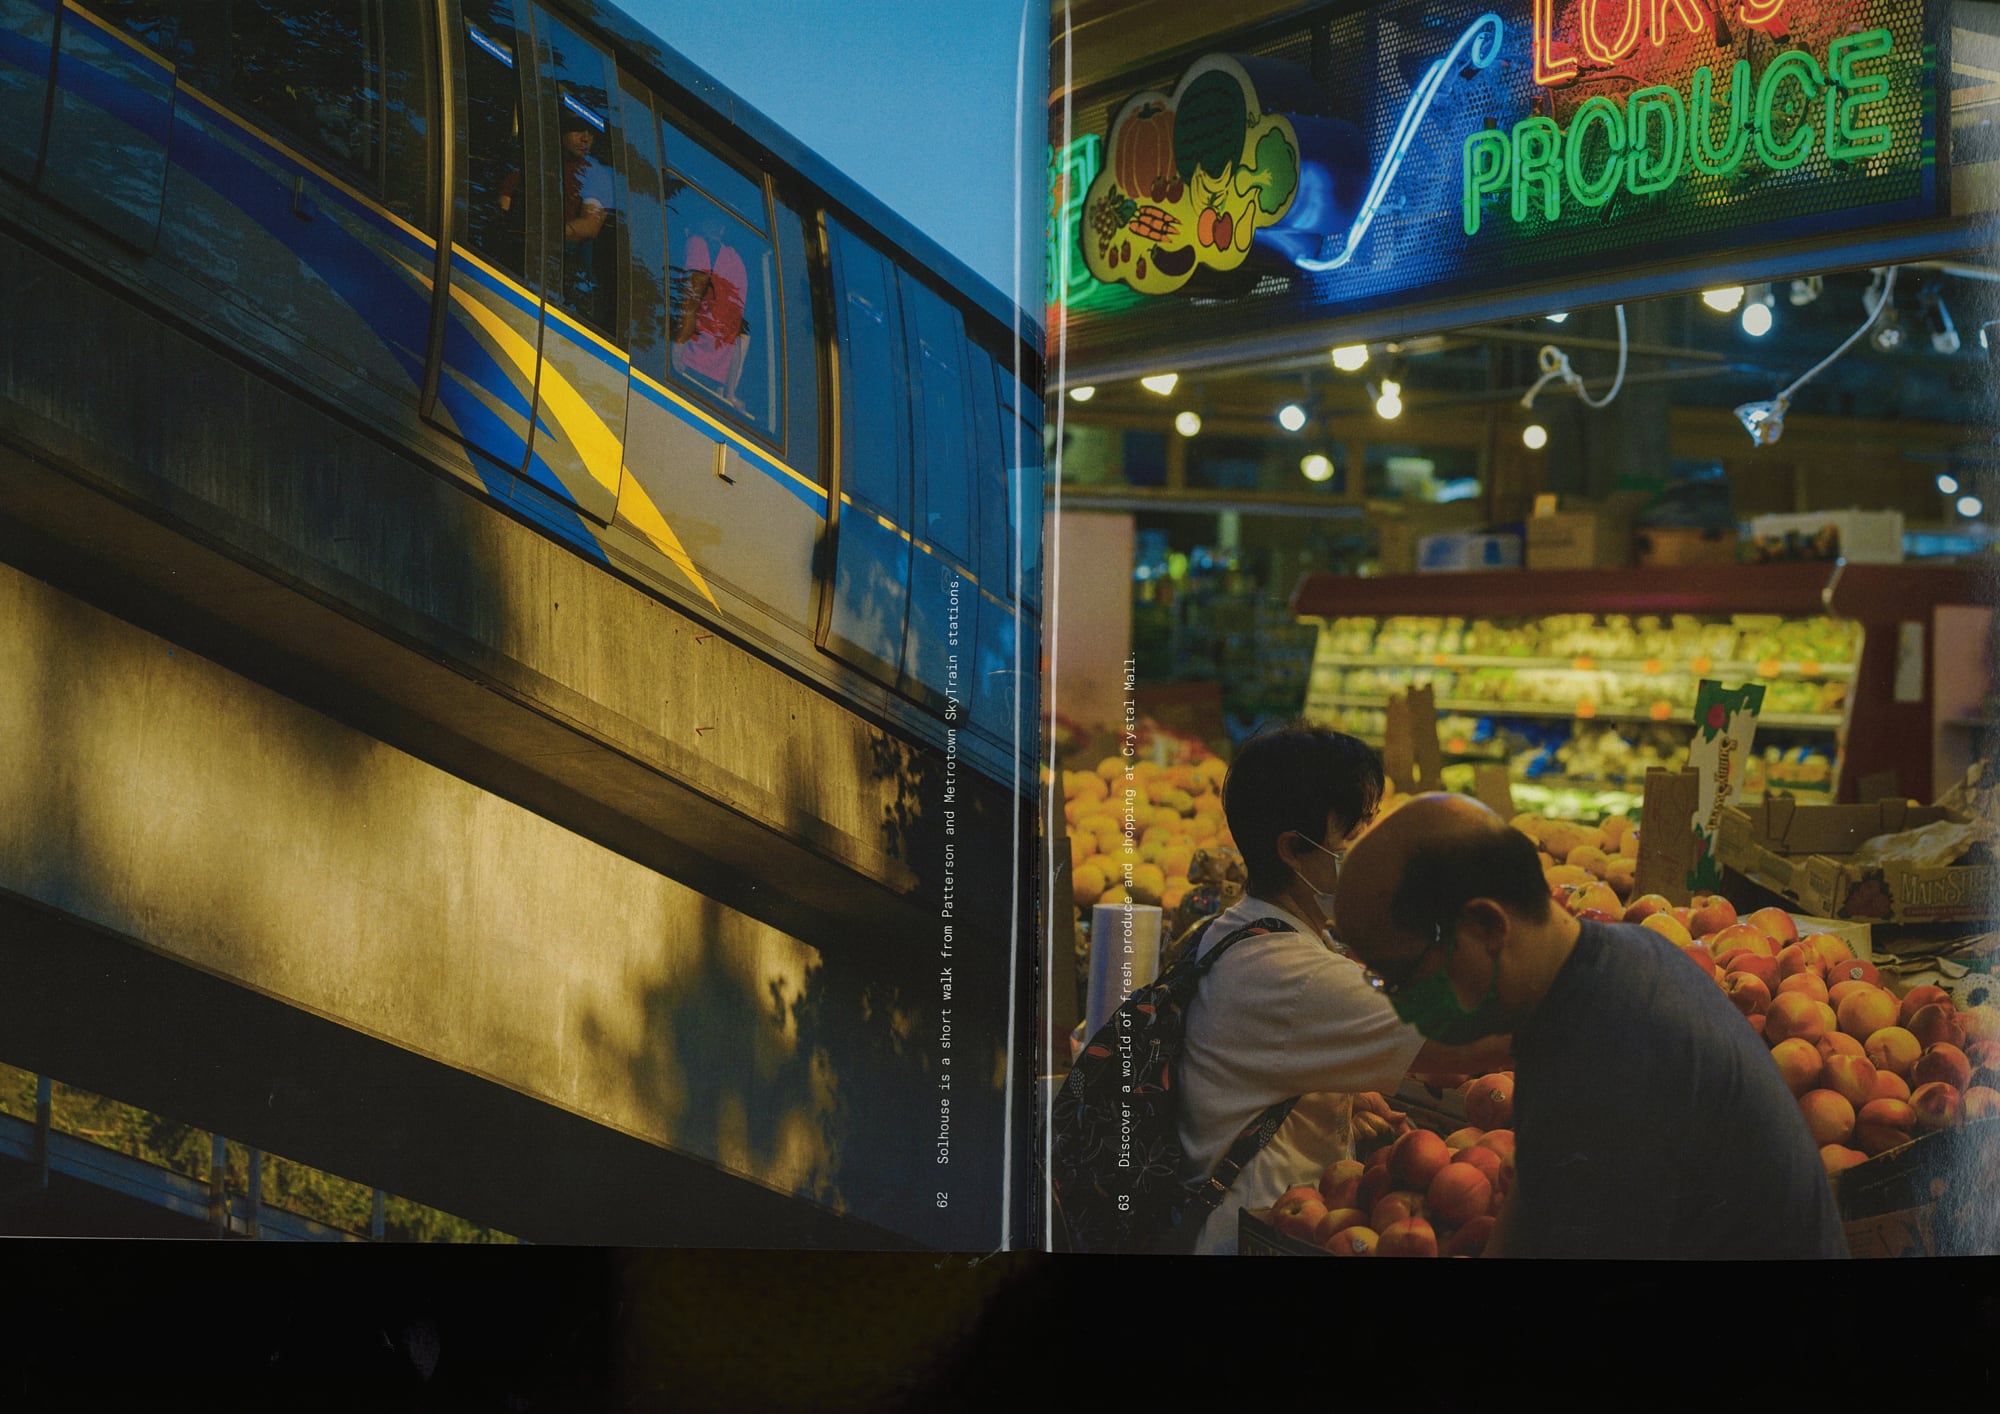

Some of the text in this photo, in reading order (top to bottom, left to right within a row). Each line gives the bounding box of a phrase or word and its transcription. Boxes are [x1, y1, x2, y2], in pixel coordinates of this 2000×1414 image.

[1463, 28, 1893, 236] PRODUCE
[947, 575, 960, 645] stations.
[945, 656, 959, 720] SkyTrain
[1124, 652, 1136, 690] Mall.
[1123, 699, 1137, 756] Crystal
[944, 730, 956, 802] Metrotown
[1124, 766, 1134, 780] at
[944, 811, 954, 835] and
[1123, 790, 1136, 853] shopping
[942, 845, 954, 917] Patterson
[1122, 864, 1132, 887] and
[941, 926, 952, 958] from
[1122, 896, 1135, 953] produce
[940, 968, 952, 1000] walk
[1120, 963, 1132, 1002] fresh
[940, 1009, 951, 1048] short
[1120, 1012, 1131, 1029] of
[1120, 1036, 1132, 1077] world
[939, 1075, 950, 1090] is
[937, 1099, 949, 1164] Solhouse
[1119, 1102, 1130, 1167] Discover
[937, 1192, 948, 1208] 62
[1118, 1195, 1129, 1210] 63
